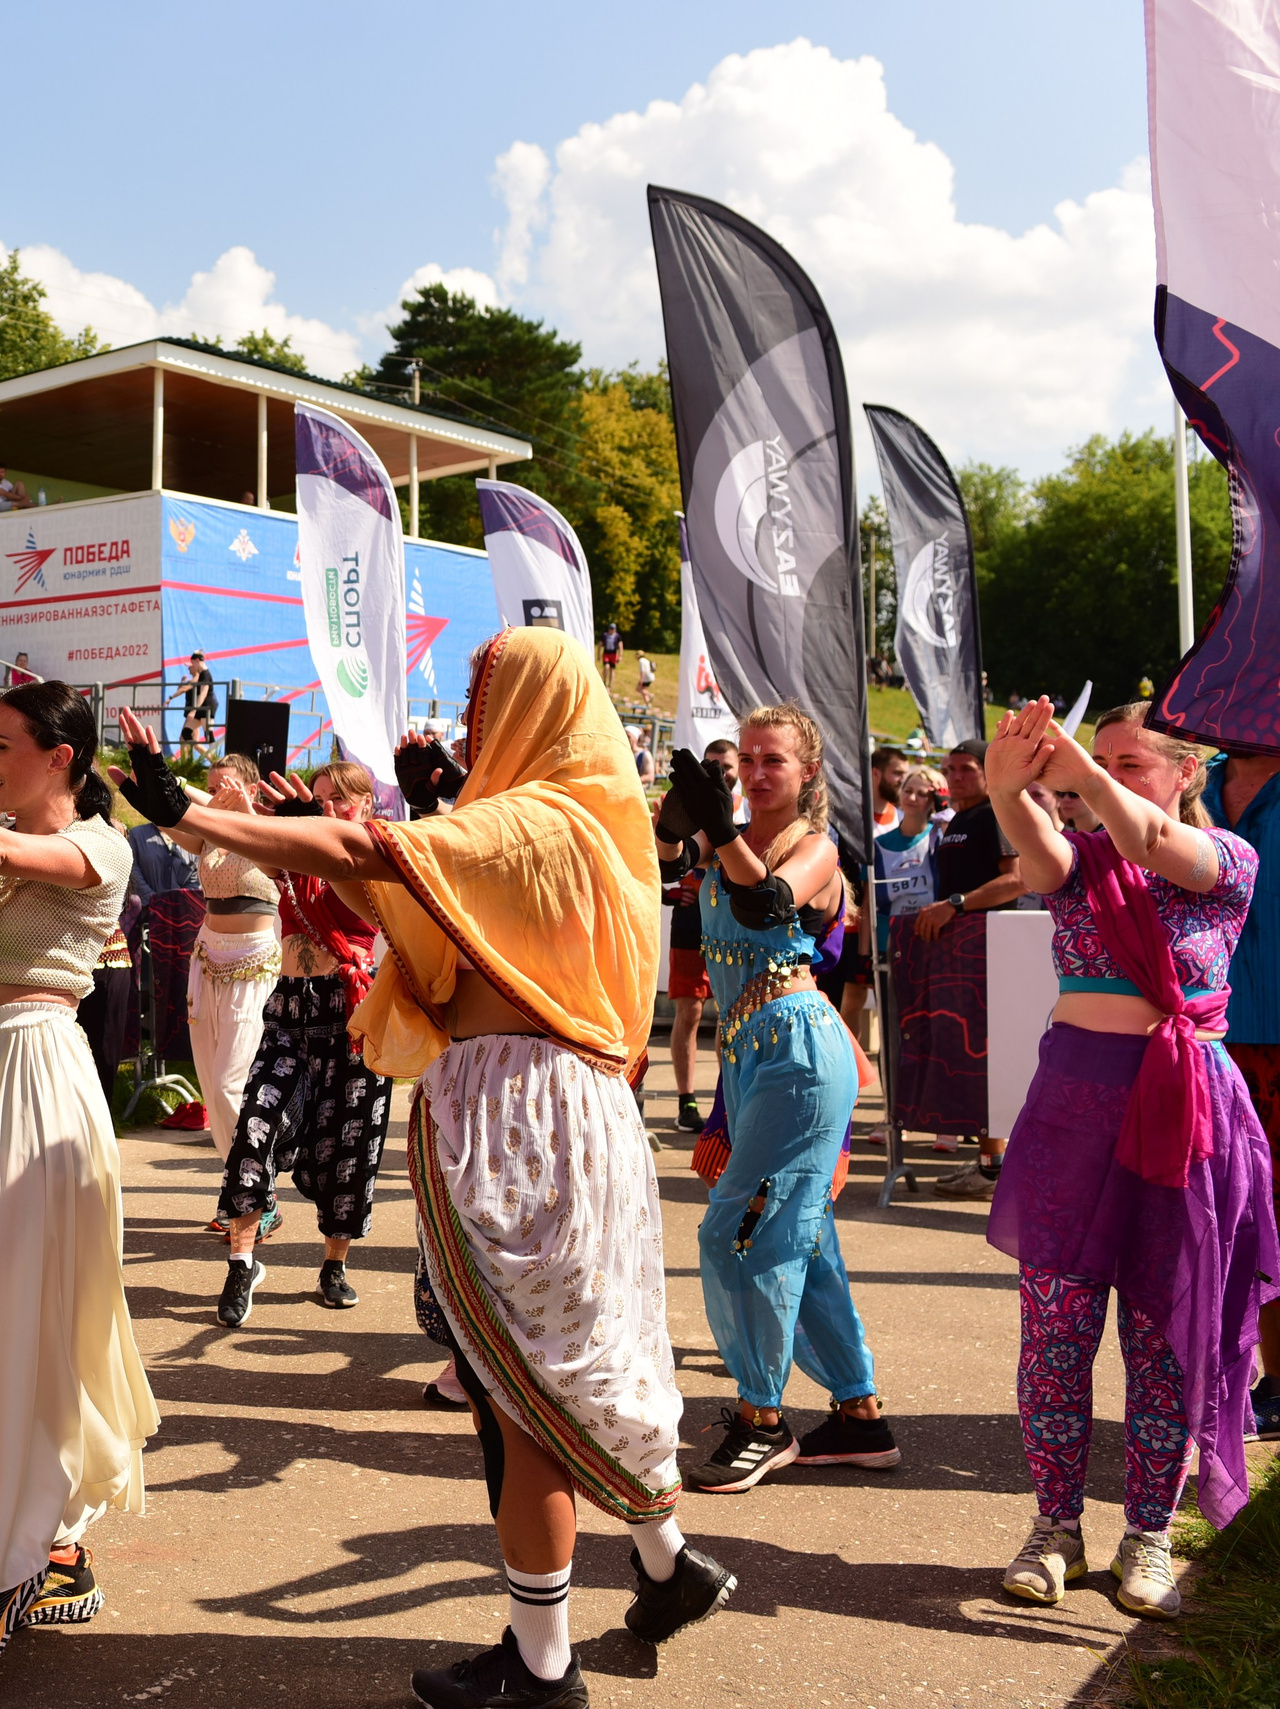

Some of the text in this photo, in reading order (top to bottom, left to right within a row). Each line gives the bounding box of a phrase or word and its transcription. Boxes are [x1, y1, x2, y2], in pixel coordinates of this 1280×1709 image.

[63, 539, 131, 566] ПОБЕДА
[63, 567, 107, 582] юнармия
[67, 644, 149, 661] #ПОБЕДА2022
[892, 875, 927, 892] 5871
